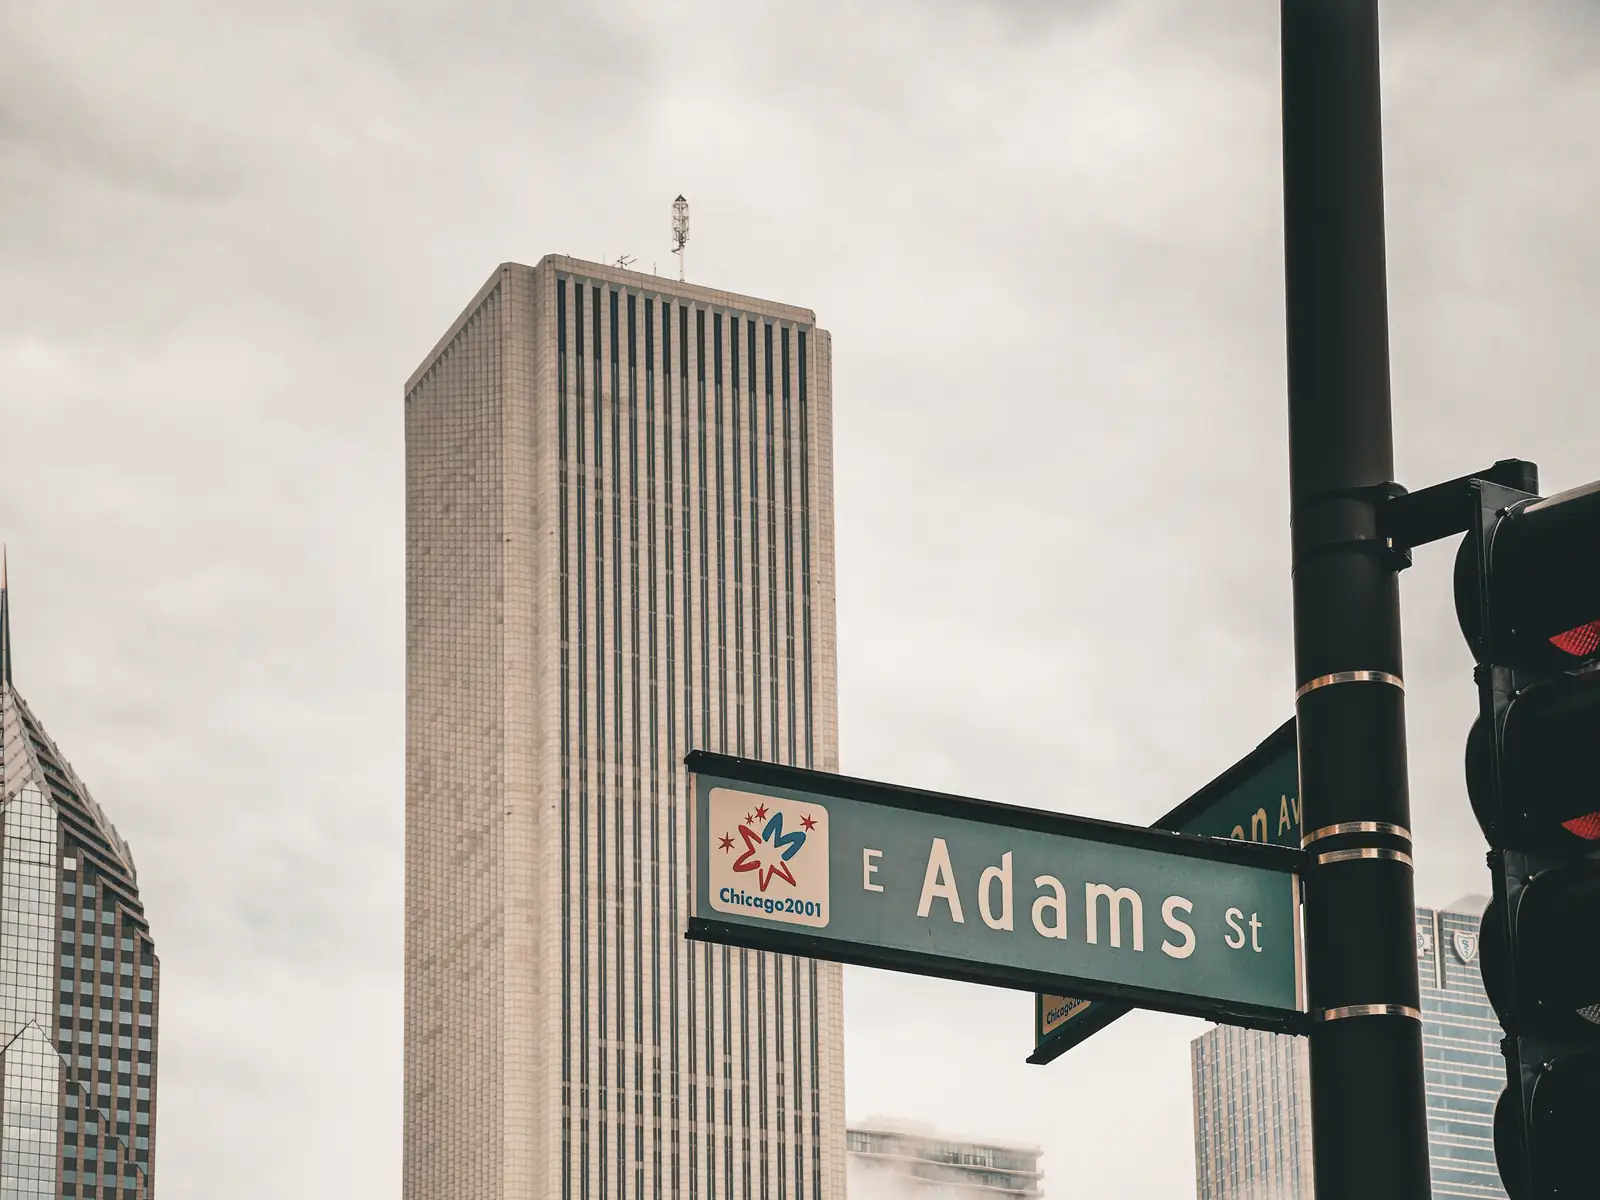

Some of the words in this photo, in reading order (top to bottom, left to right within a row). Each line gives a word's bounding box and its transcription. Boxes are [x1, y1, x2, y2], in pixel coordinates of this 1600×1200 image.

[720, 888, 821, 918] Chicago2001
[864, 848, 884, 893] E
[917, 838, 1196, 959] Adams
[1224, 907, 1263, 953] St
